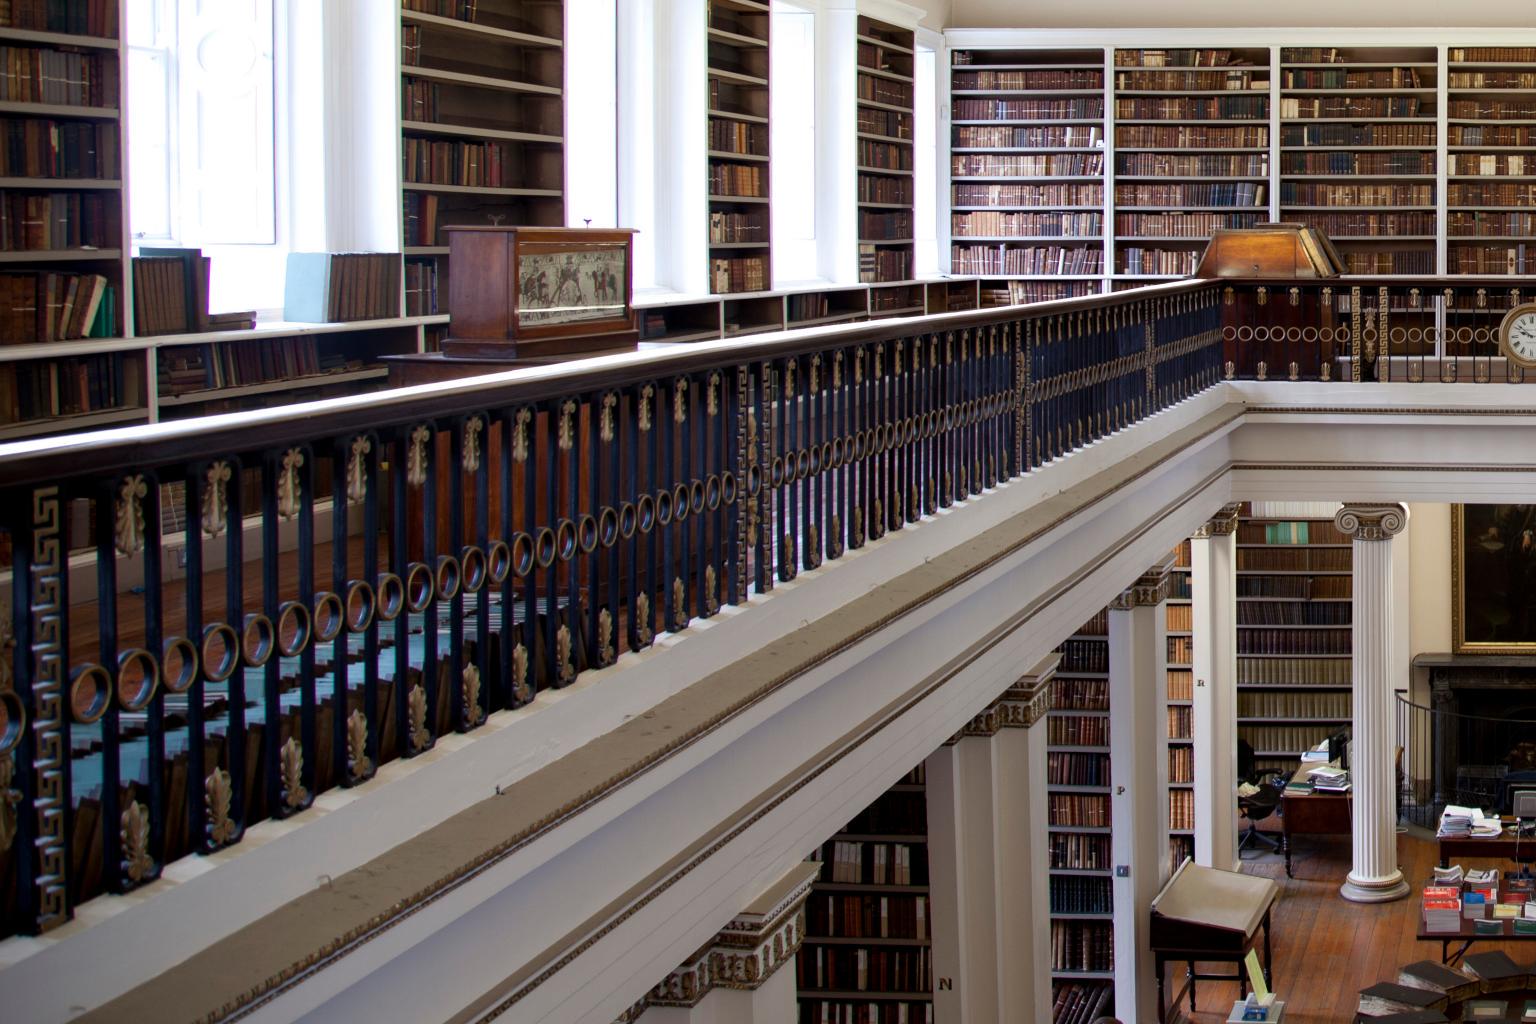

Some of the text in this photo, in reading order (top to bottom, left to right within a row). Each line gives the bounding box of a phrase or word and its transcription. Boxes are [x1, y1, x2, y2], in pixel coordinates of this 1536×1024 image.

[1197, 679, 1205, 687] R
[1117, 786, 1125, 795] P
[938, 978, 952, 991] N
